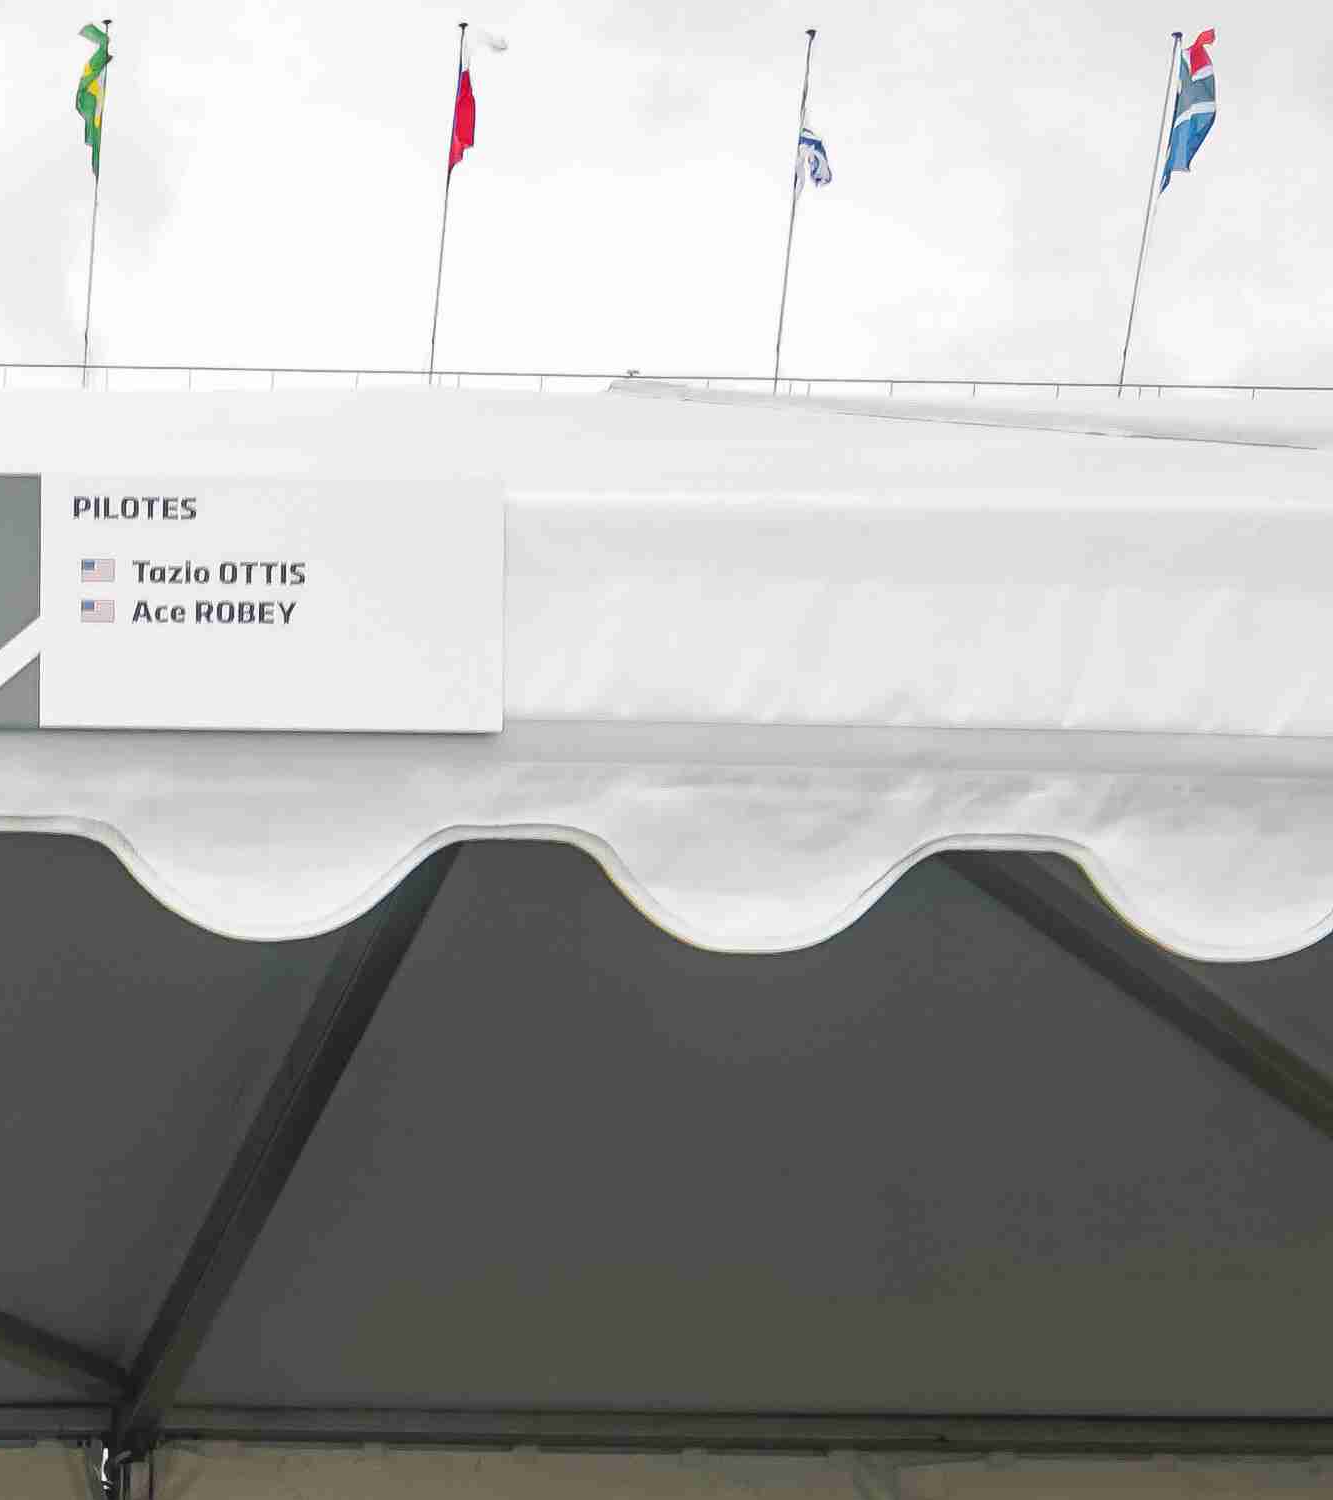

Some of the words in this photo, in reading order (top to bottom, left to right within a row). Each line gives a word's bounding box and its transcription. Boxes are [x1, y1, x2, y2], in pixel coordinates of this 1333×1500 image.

[73, 496, 197, 520] PILOTES
[132, 560, 210, 585] Tazio
[219, 561, 306, 585] OTTIS
[132, 600, 186, 624] Ace
[195, 600, 297, 624] ROBEY
